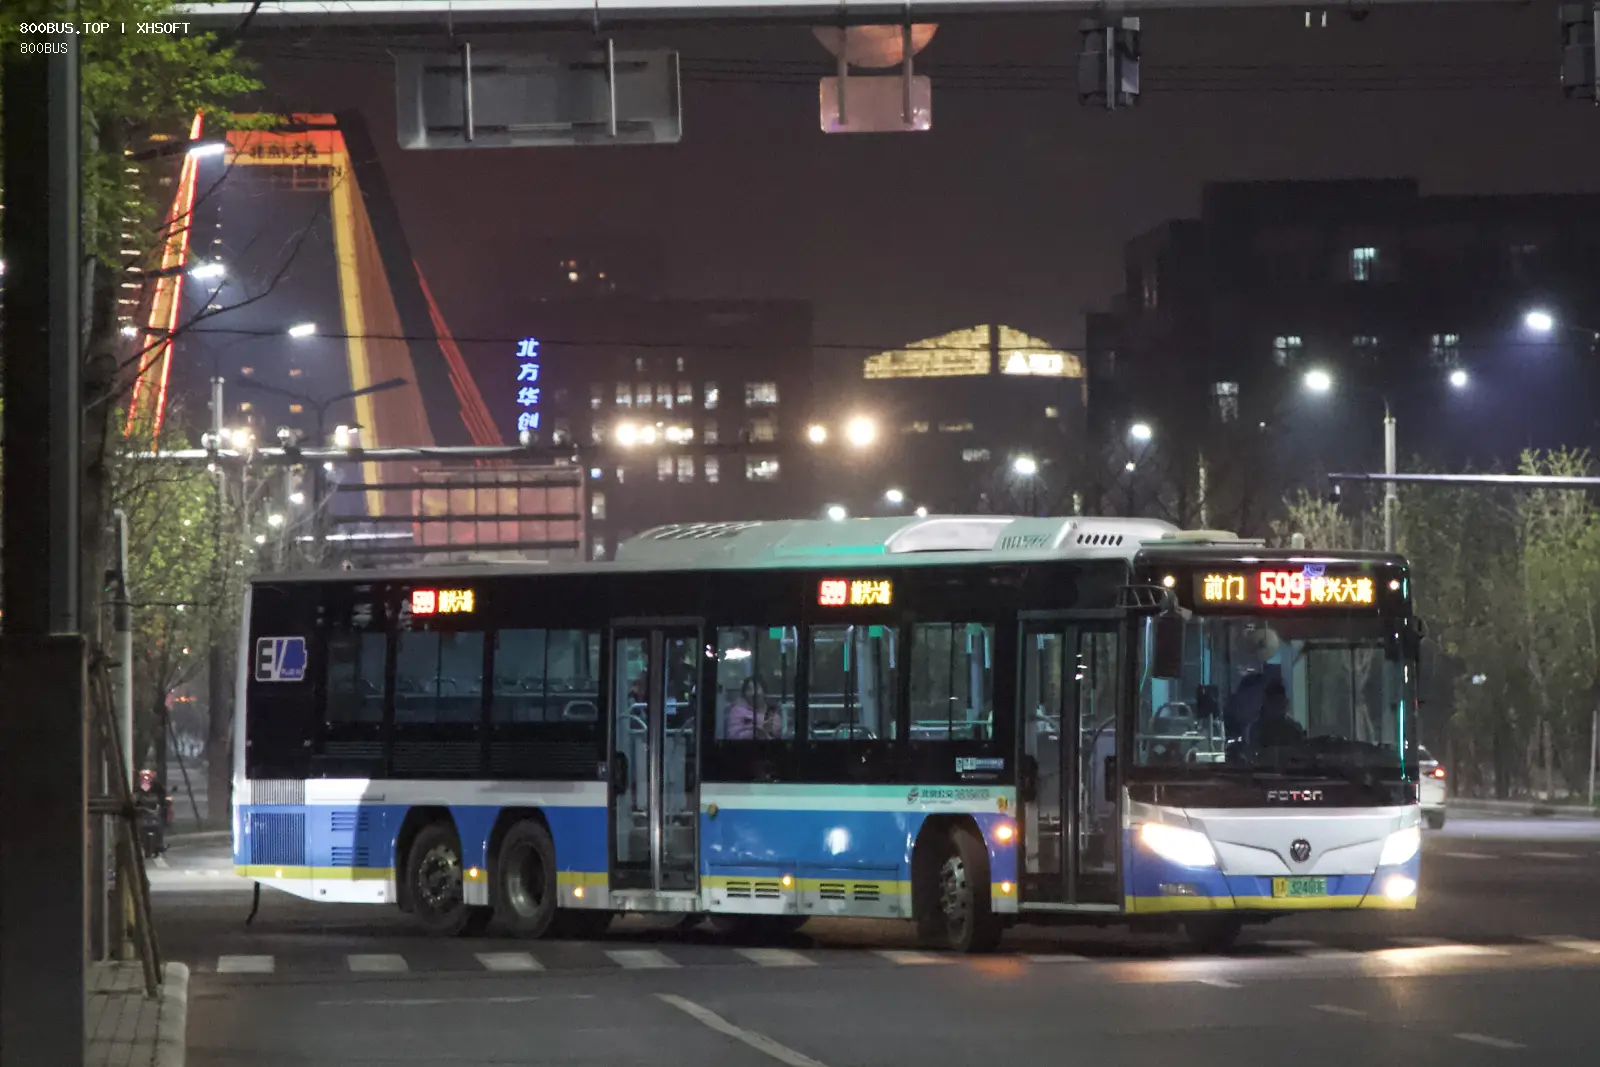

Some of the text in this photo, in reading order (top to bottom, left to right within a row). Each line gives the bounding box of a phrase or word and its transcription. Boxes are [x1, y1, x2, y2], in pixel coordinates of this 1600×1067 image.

[516, 337, 540, 431] 北方华创
[820, 580, 847, 605] 599
[1204, 574, 1245, 601] 前门
[1259, 571, 1306, 606] 599
[412, 590, 435, 614] 599
[1267, 790, 1323, 802] FOTON
